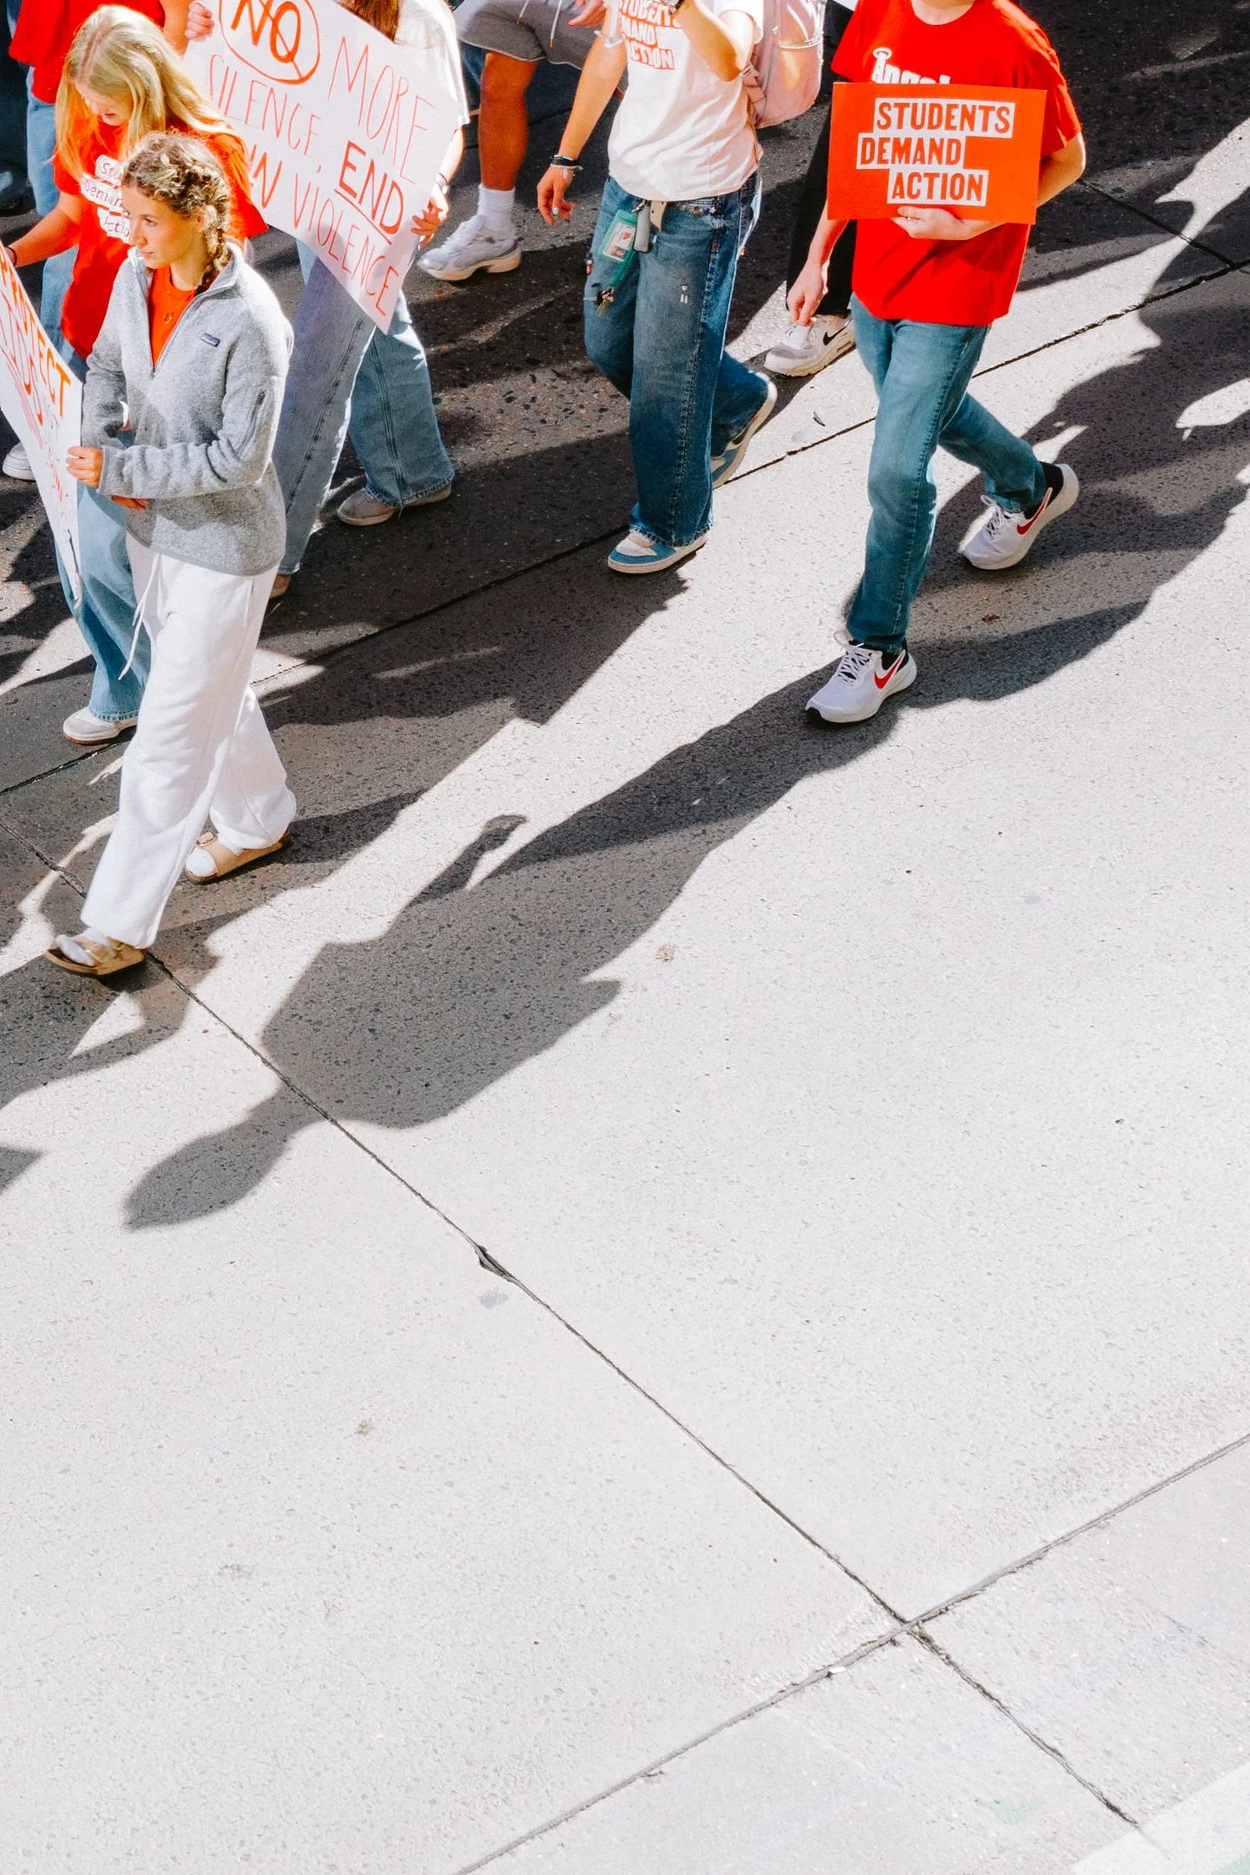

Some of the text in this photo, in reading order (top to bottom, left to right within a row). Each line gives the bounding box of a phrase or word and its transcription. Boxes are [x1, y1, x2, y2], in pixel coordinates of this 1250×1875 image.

[327, 36, 436, 186] MORE
[876, 101, 1011, 134] STUDENTS
[860, 136, 962, 166] DEMAND
[337, 139, 405, 236] END
[891, 171, 984, 202] ACTION
[292, 172, 400, 318] VIOLENCE
